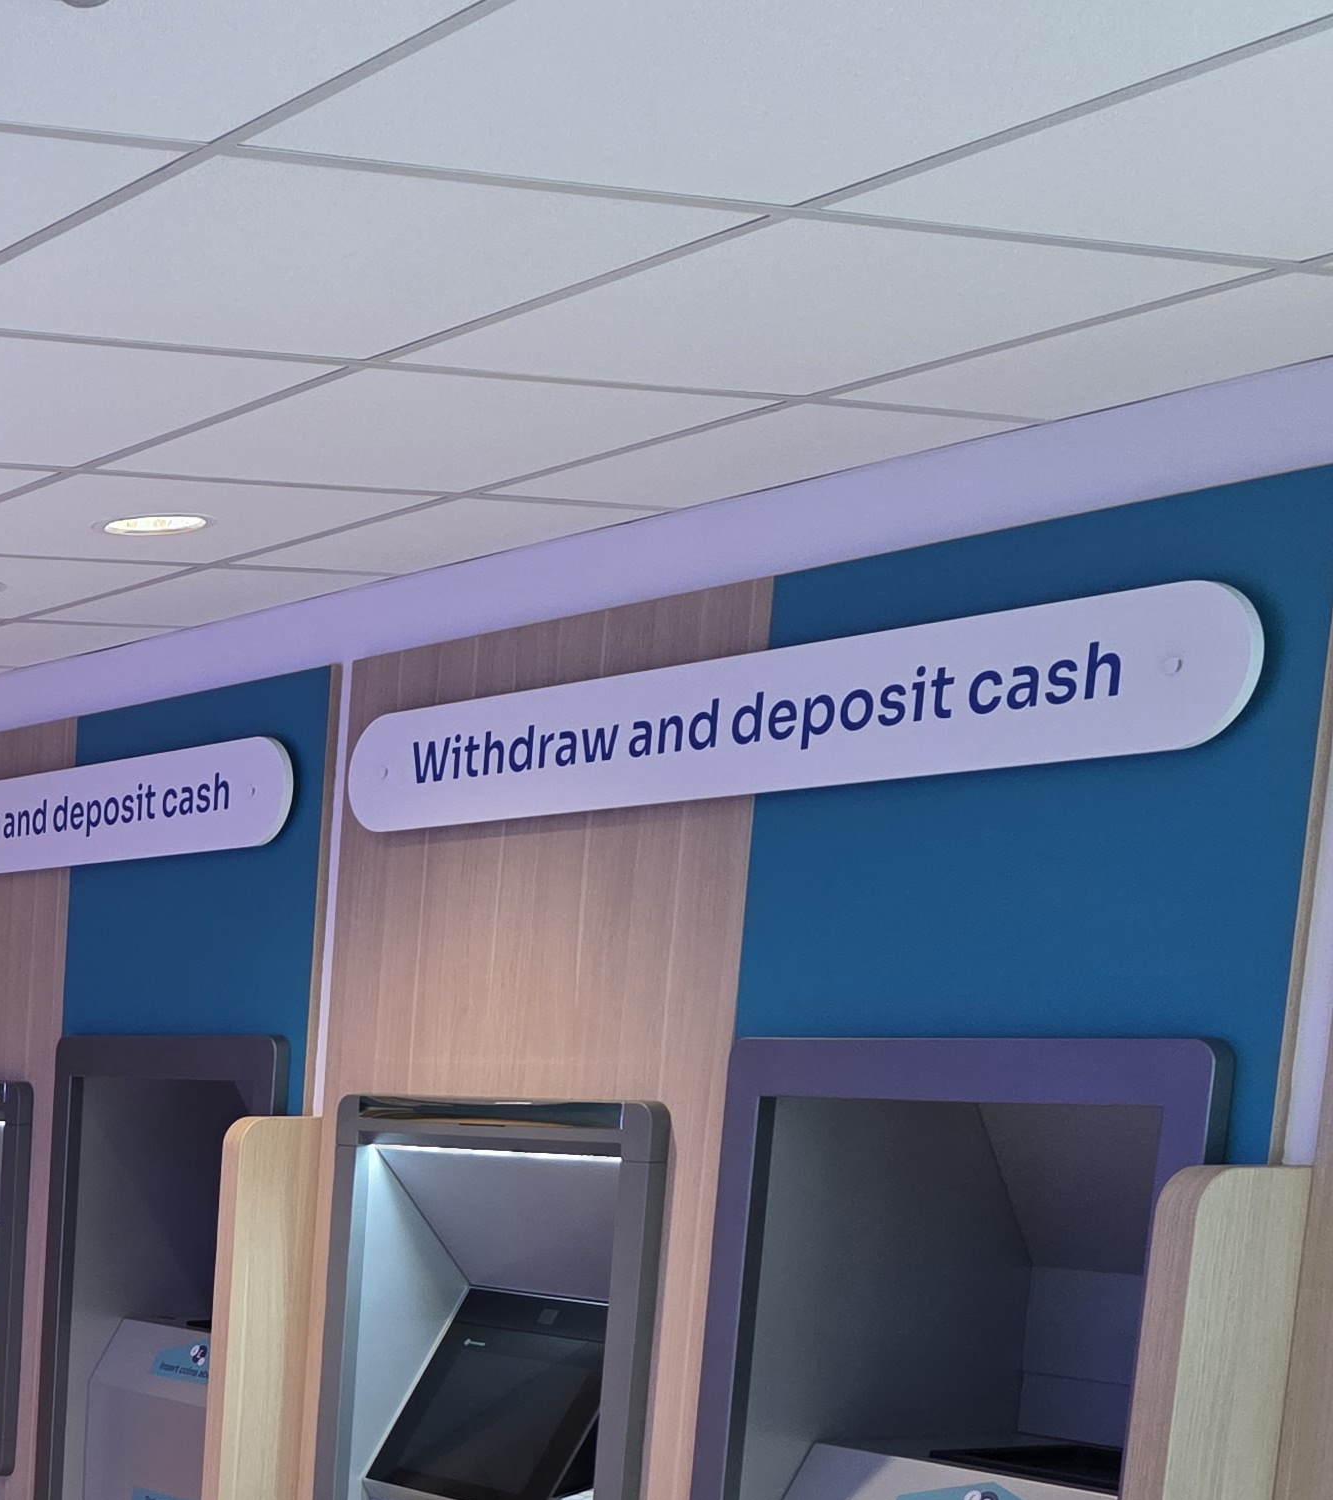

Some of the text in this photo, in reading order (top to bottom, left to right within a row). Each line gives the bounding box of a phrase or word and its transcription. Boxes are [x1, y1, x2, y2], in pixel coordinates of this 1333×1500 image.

[412, 642, 1121, 784] Withdraw and deposit cash
[3, 799, 47, 838] and
[53, 783, 156, 837] deposit
[162, 772, 229, 818] cash
